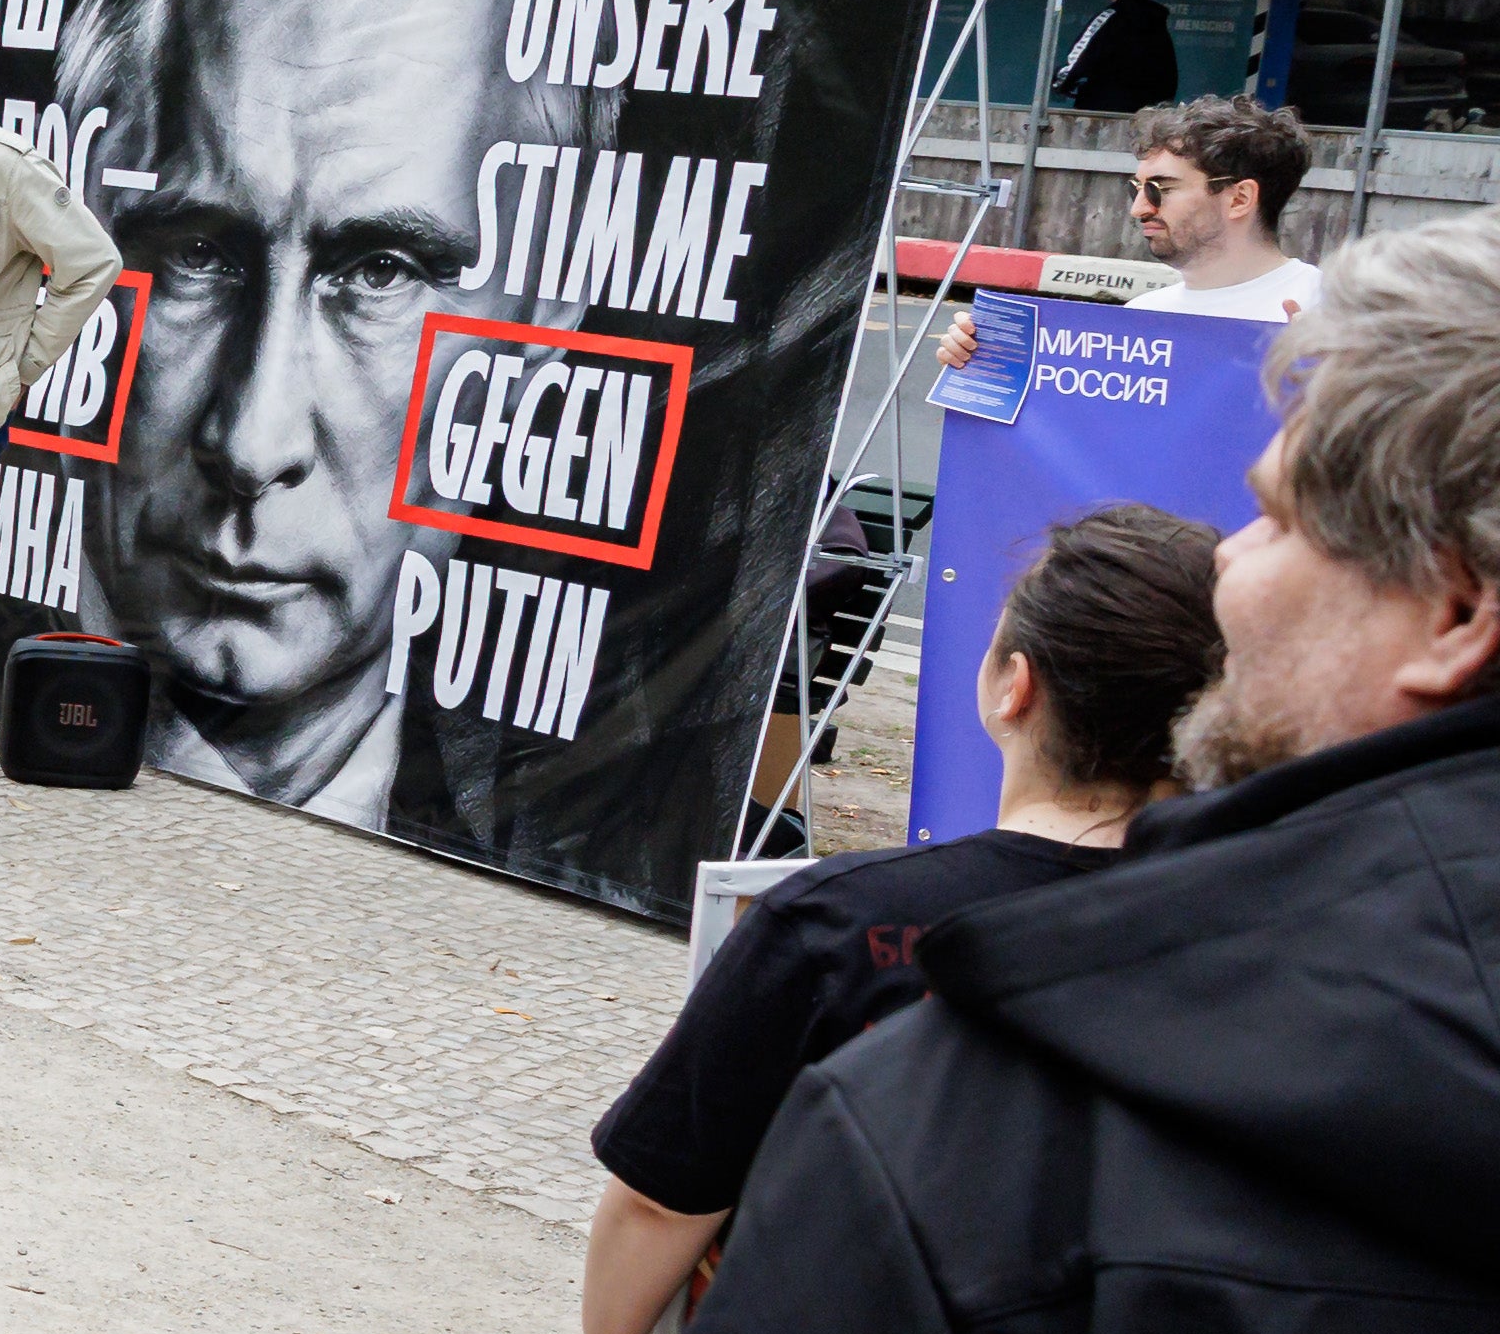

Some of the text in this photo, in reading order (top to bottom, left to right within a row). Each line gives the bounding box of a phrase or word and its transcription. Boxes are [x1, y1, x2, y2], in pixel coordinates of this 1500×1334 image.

[458, 140, 767, 323] STIMME
[1051, 269, 1134, 289] ZEPPELIN
[1038, 326, 1173, 368] МИРНАЯ
[1034, 364, 1169, 406] РОССИЯ
[429, 347, 650, 531] GEGEN
[384, 549, 610, 742] PUTIN
[60, 702, 98, 727] JBL
